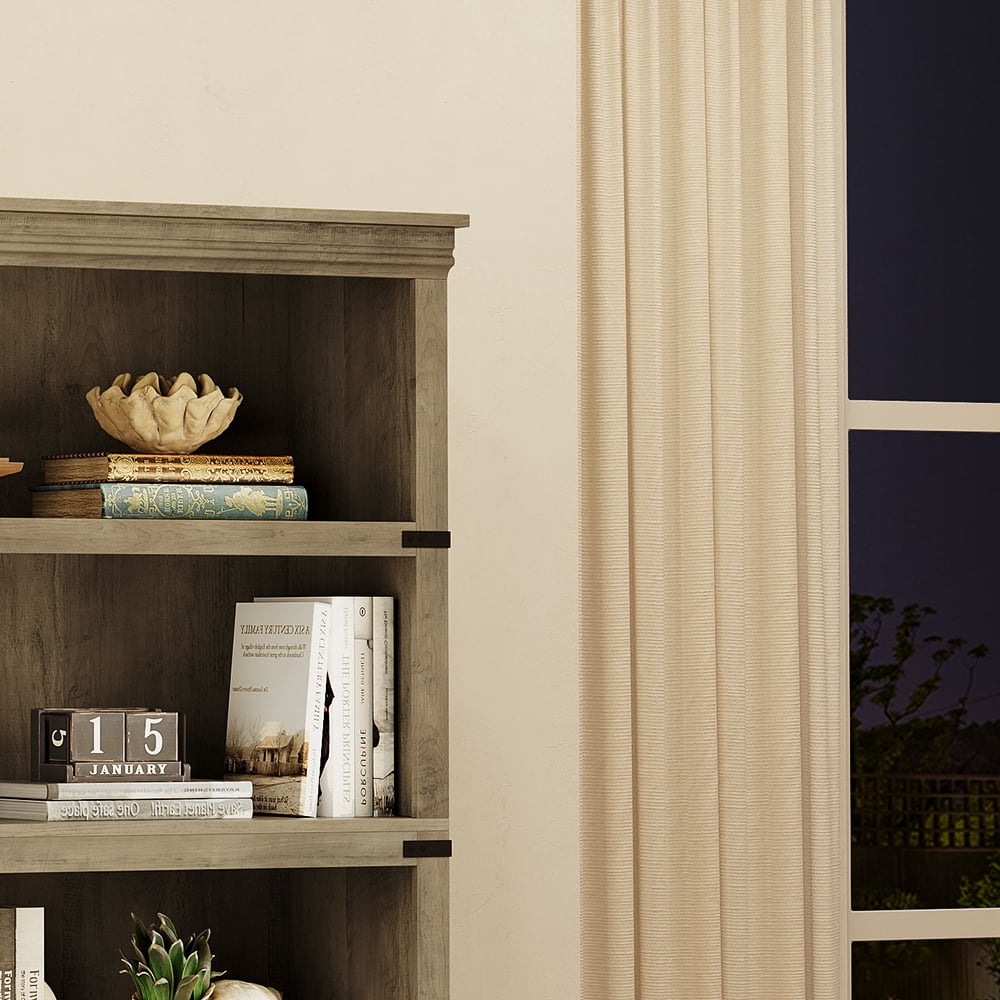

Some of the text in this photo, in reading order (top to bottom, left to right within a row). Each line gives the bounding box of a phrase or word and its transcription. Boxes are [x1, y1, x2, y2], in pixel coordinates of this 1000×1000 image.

[89, 716, 163, 756] 1 5
[89, 763, 167, 775] JANUARY
